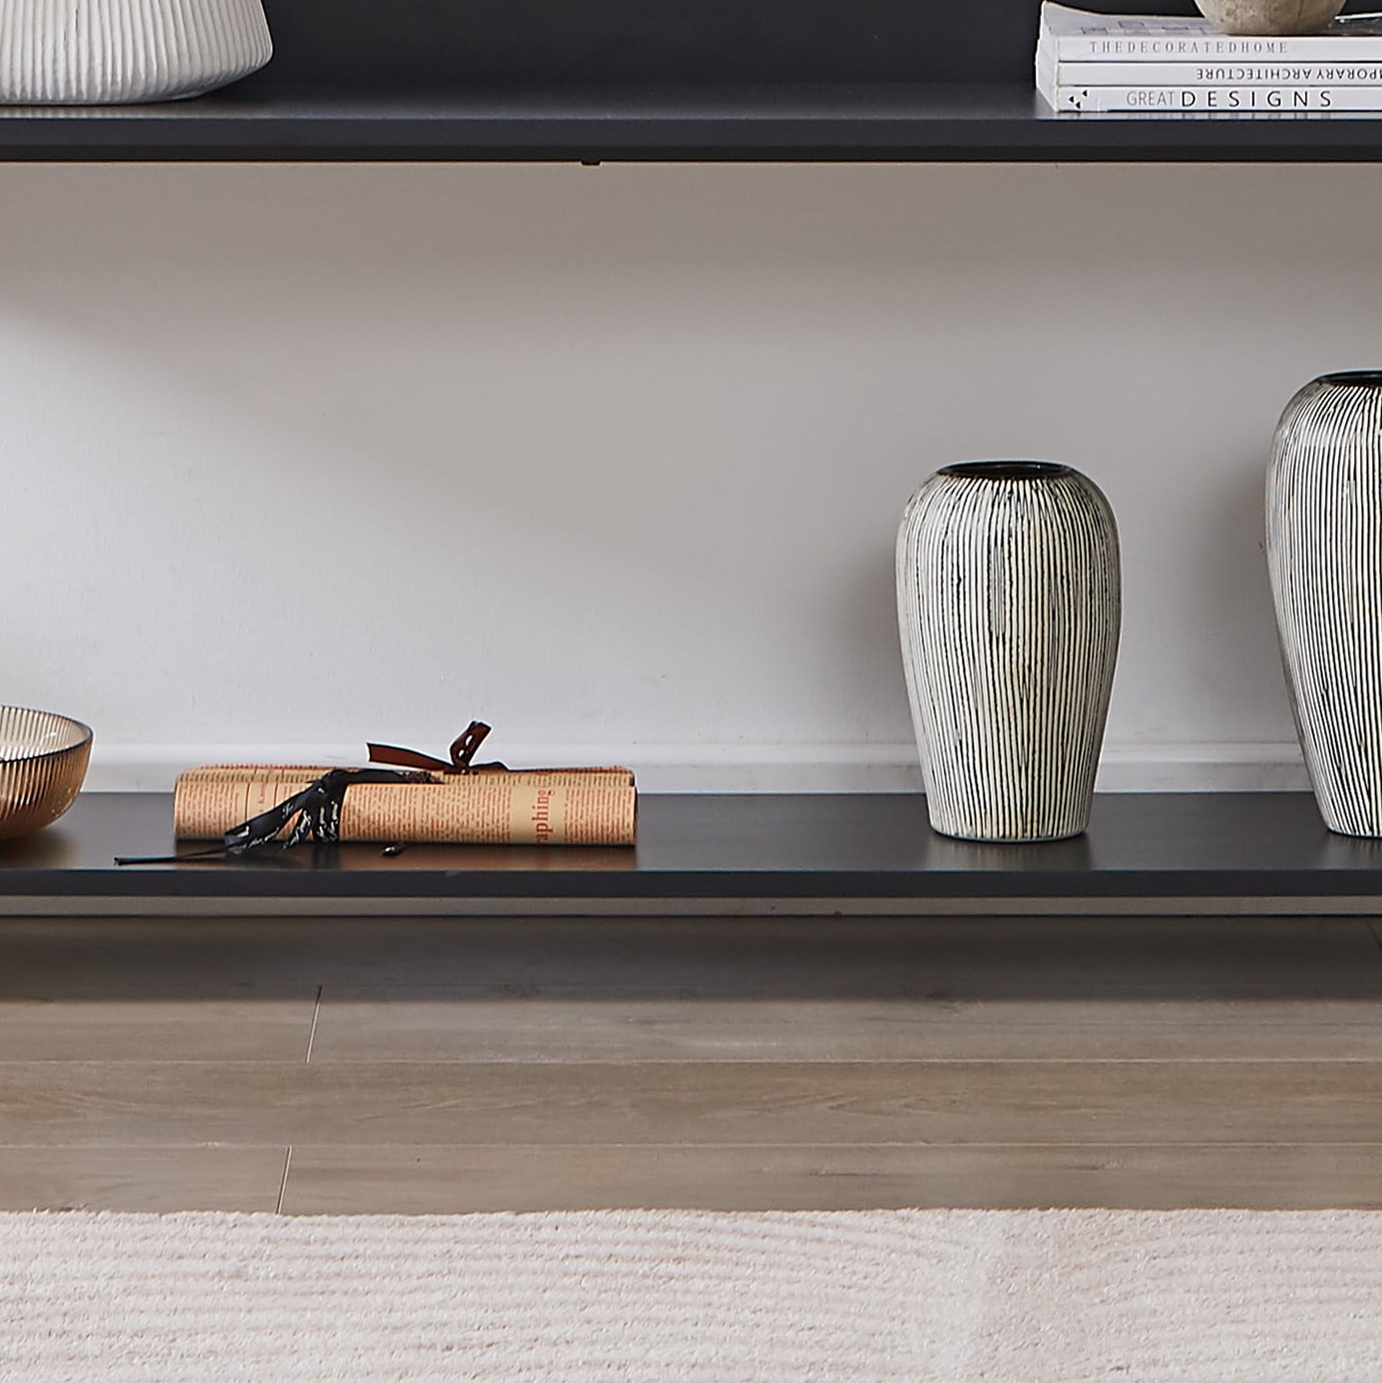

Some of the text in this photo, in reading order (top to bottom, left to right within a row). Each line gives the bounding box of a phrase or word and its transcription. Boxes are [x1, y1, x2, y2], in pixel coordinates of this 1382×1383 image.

[1196, 68, 1312, 80] ARCHITECTURE
[1125, 90, 1332, 108] GREAT DESIGNS
